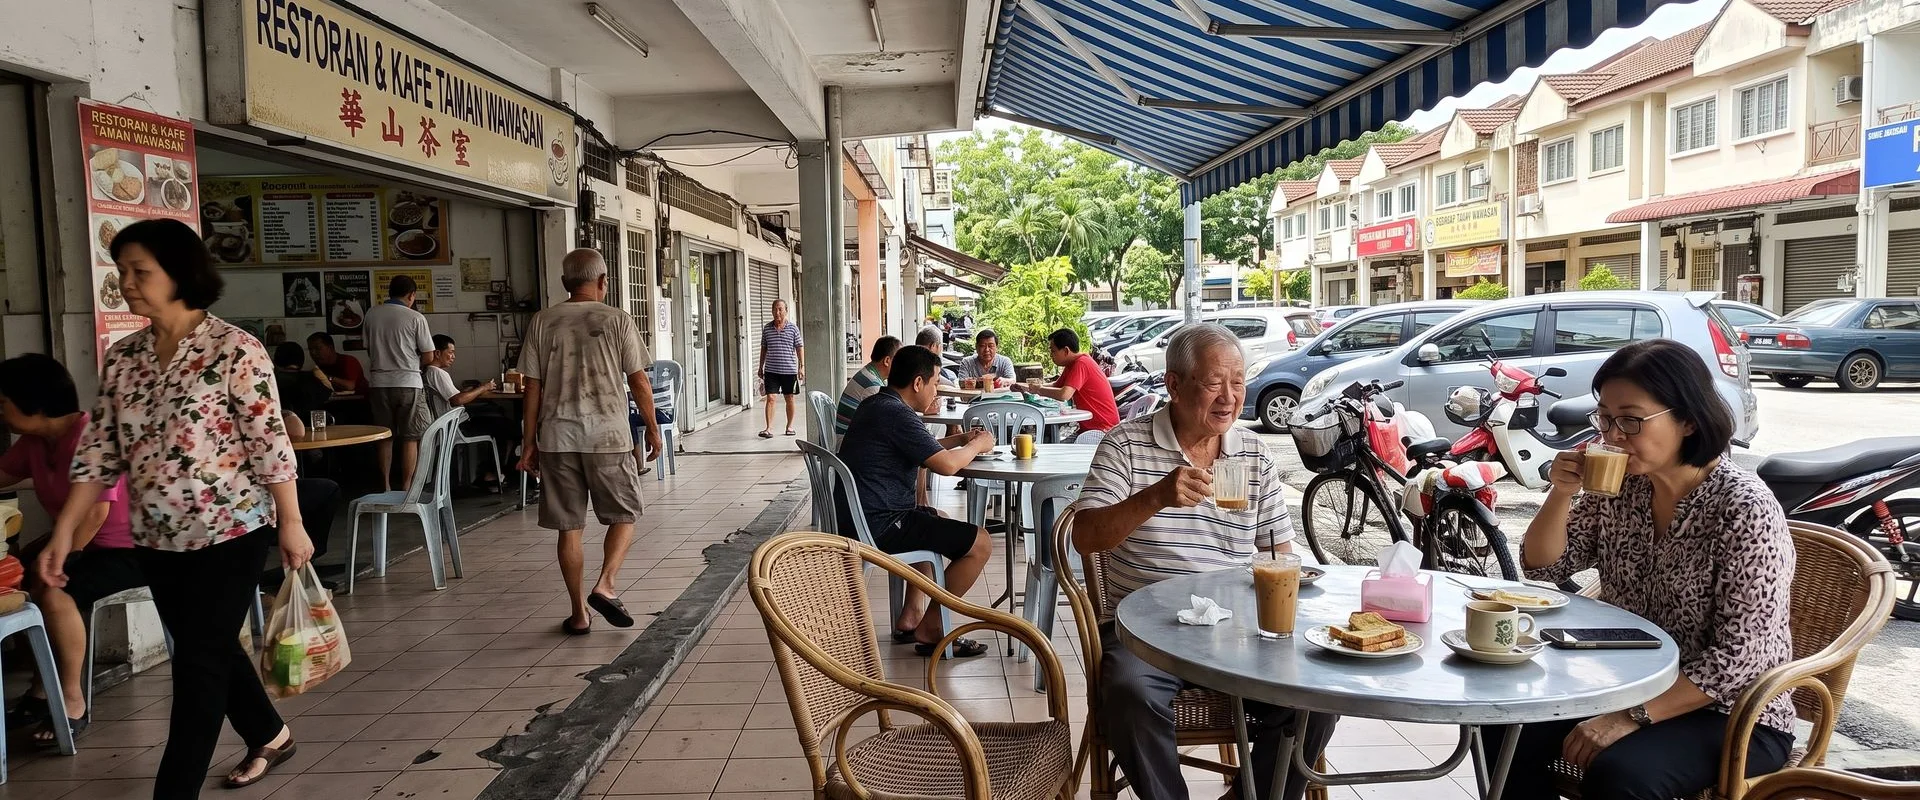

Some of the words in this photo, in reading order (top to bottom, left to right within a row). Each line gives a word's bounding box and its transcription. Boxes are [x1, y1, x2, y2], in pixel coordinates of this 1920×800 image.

[257, 0, 369, 85] RESTORAN
[375, 41, 387, 92] &
[391, 48, 433, 110] KAFE
[435, 68, 484, 129] TAMAN
[485, 90, 544, 151] WAWASAN
[91, 110, 148, 133] RESTORAN
[150, 123, 158, 135] &
[160, 125, 186, 141] KAFE
[92, 124, 131, 142] TAMAN
[133, 132, 184, 153] WAWASAN
[338, 87, 471, 168] 華山茶室
